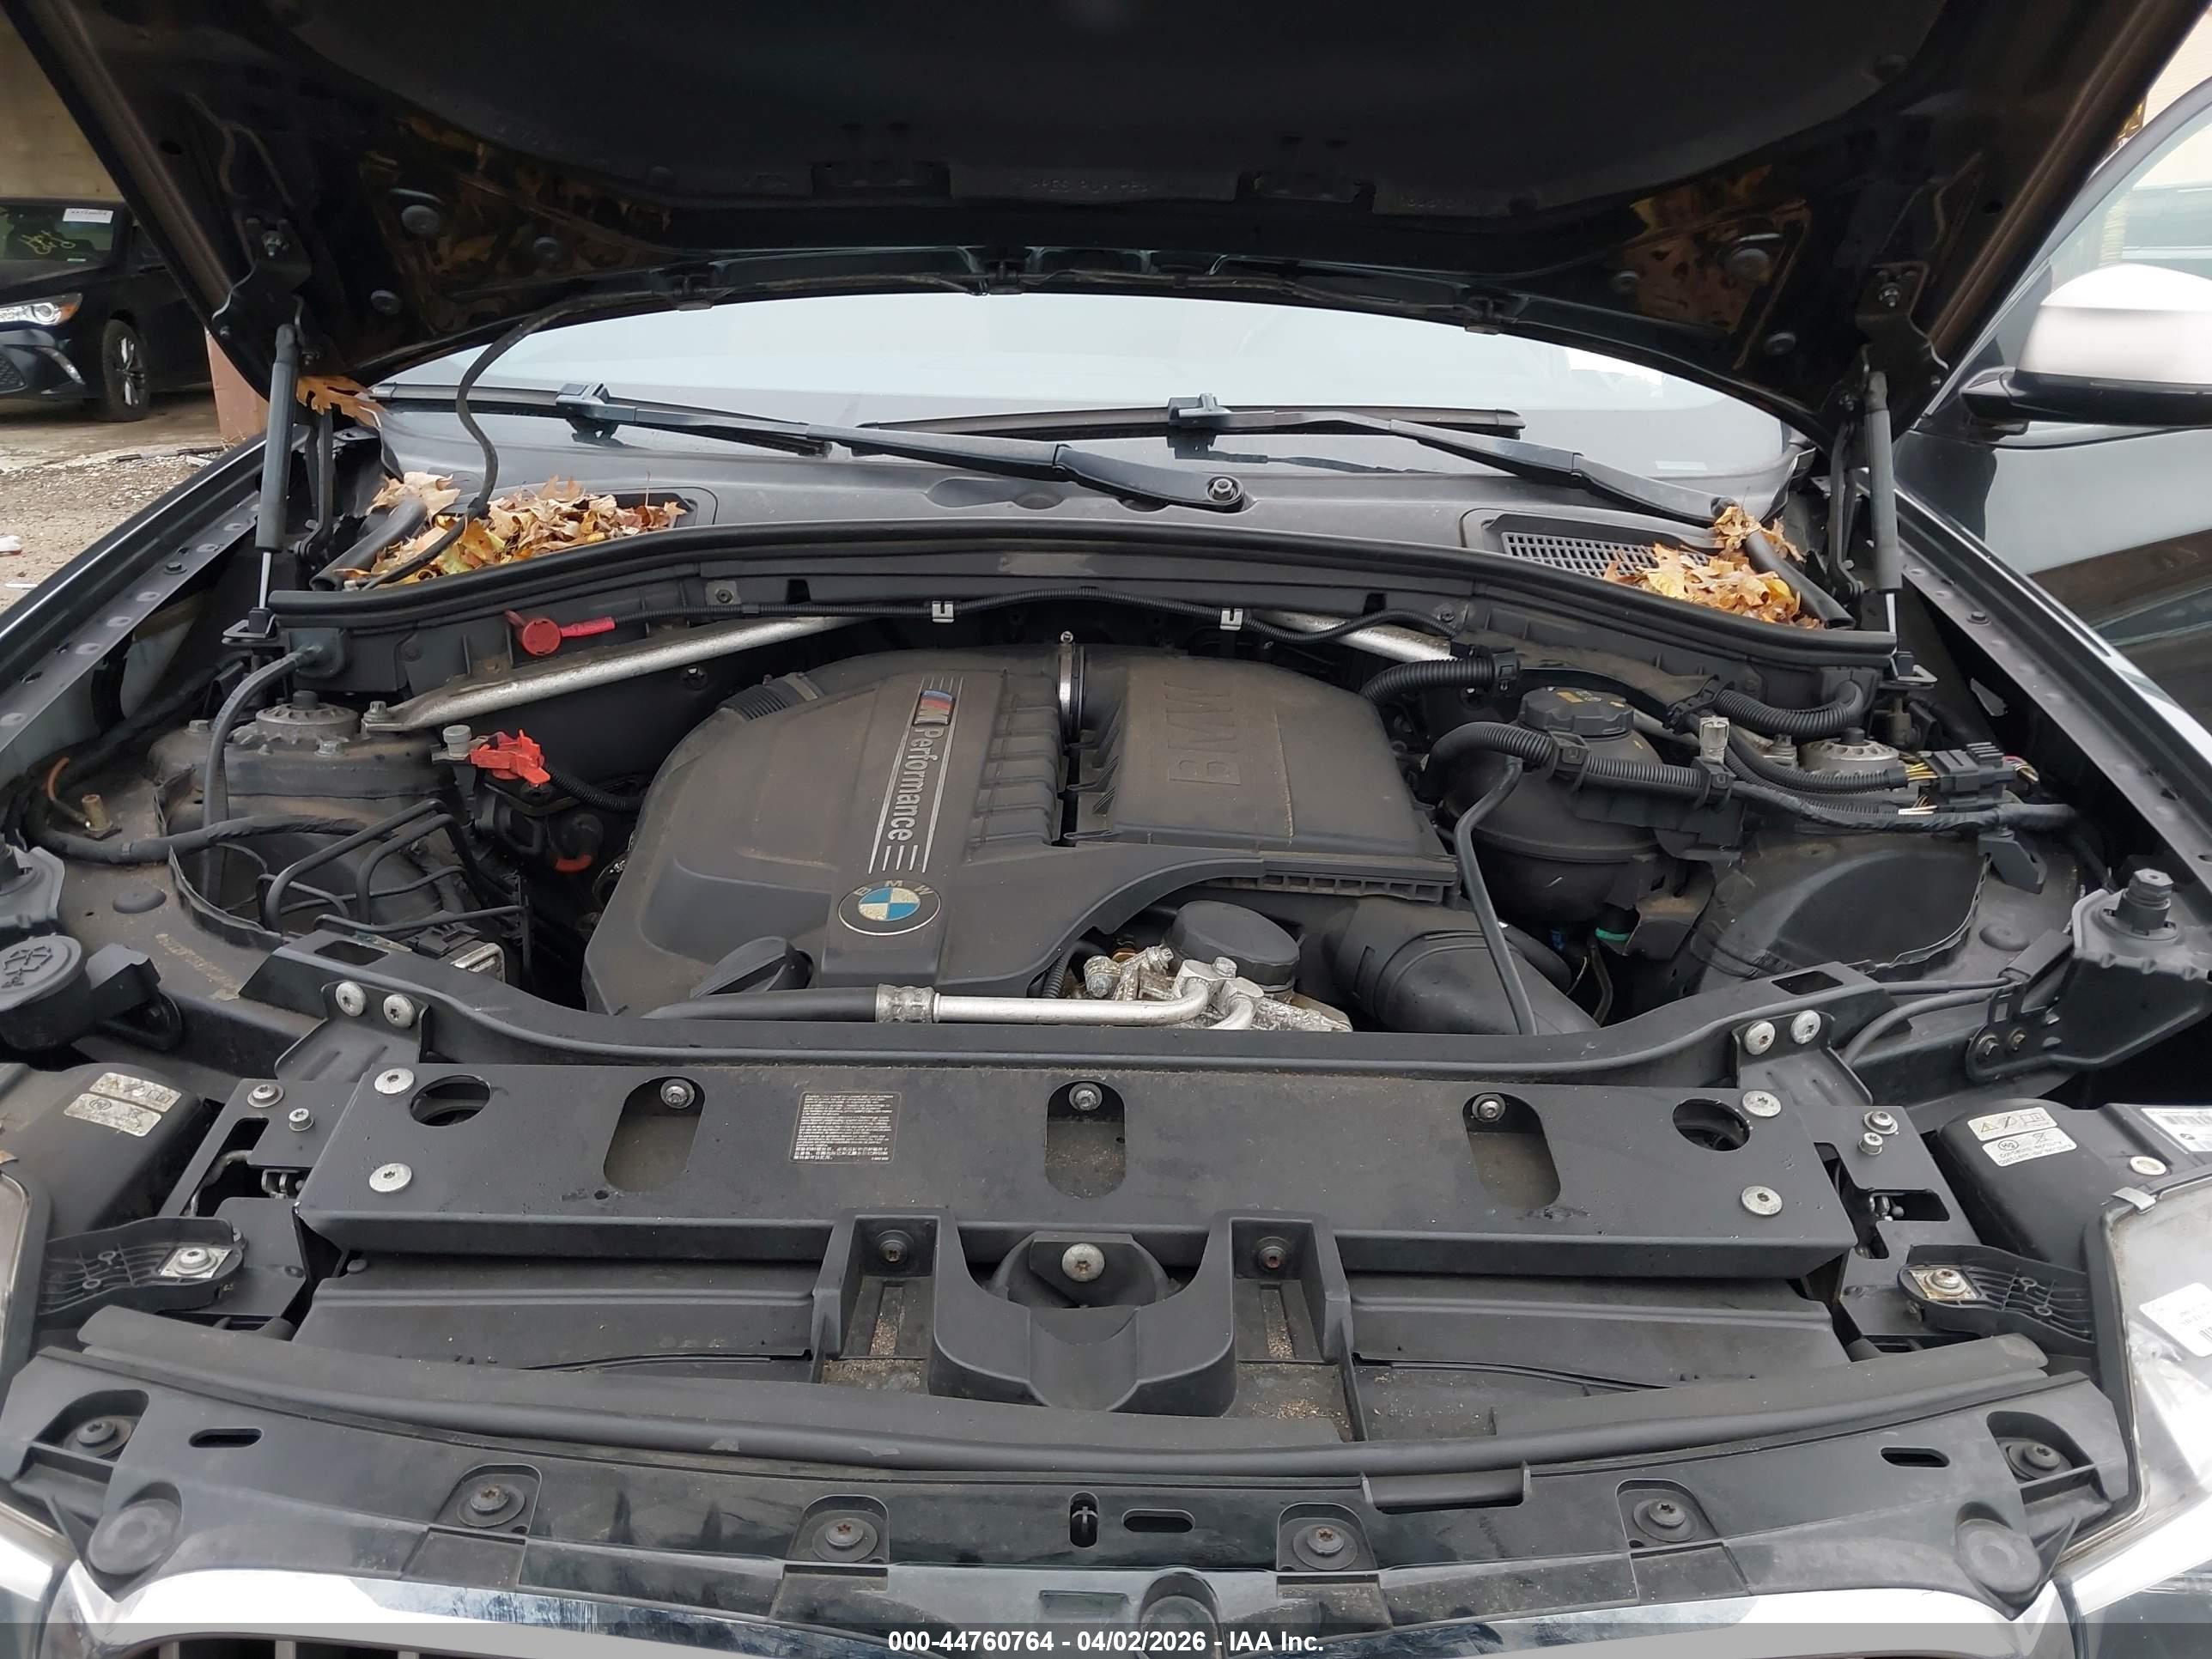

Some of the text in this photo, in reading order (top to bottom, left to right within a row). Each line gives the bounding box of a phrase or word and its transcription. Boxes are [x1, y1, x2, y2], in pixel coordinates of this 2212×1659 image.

[888, 726, 945, 842] Performance
[1164, 682, 1242, 786] BMW
[853, 879, 934, 896] BMW
